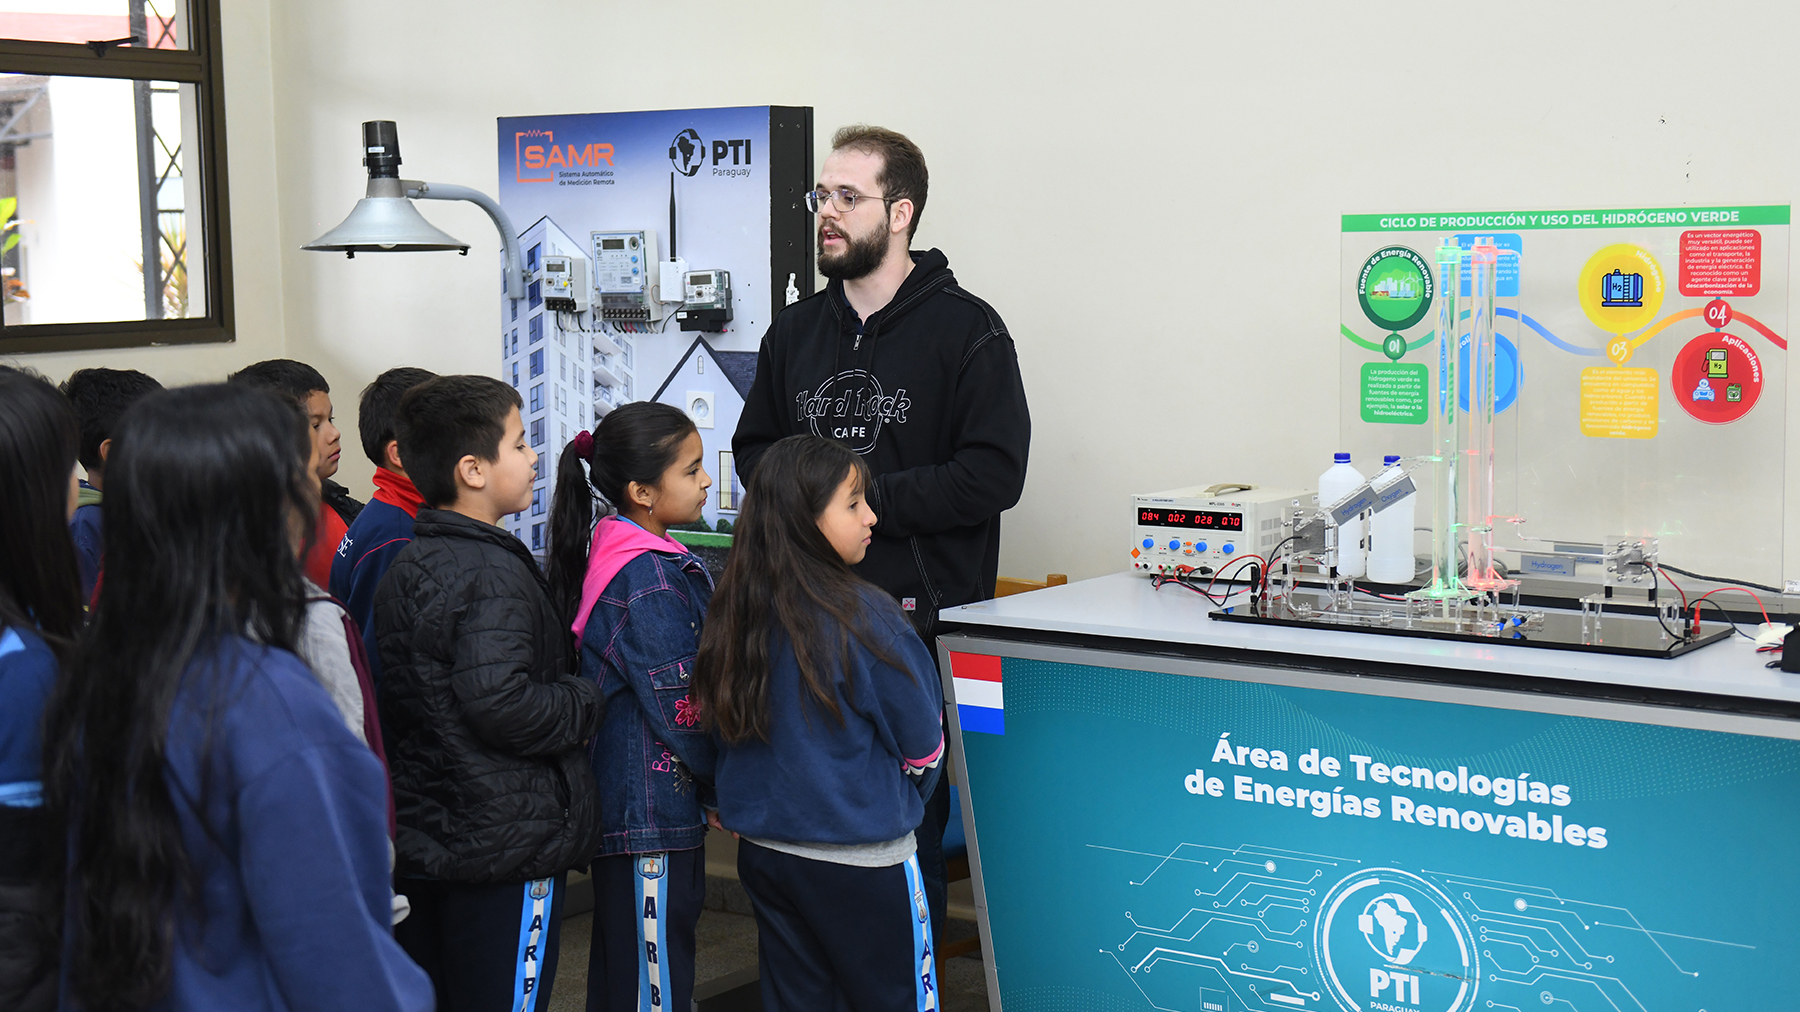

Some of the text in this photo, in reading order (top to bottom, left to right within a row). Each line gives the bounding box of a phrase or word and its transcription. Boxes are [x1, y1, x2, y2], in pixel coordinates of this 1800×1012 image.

[524, 142, 615, 169] SAMR
[712, 138, 752, 166] PTI
[582, 170, 614, 178] Automático
[712, 166, 752, 178] Paraguay
[1380, 210, 1740, 228] CICLO DE PRODUCCIÓN Y USO DEL HIDRÓGENO VERDE
[1359, 250, 1431, 298] Fuente de Energía Renovable
[1636, 250, 1662, 293] Hidrógeno
[1612, 283, 1622, 292] H2
[1709, 304, 1727, 326] 04
[1388, 338, 1400, 354] 01
[1612, 342, 1627, 361] 03
[1722, 335, 1760, 383] Aplicaciones
[796, 387, 912, 424] Hard Rock
[834, 426, 866, 439] CAFE
[1341, 497, 1367, 517] Hydrogen
[1381, 488, 1402, 502] Oxygen
[1532, 560, 1563, 570] Hydrogen
[1212, 732, 1572, 807] Área de Tecnologías
[1184, 770, 1608, 849] de Energías Renovables
[520, 914, 542, 1012] ARB
[921, 939, 935, 1012] AR
[1370, 968, 1420, 1005] PTI
